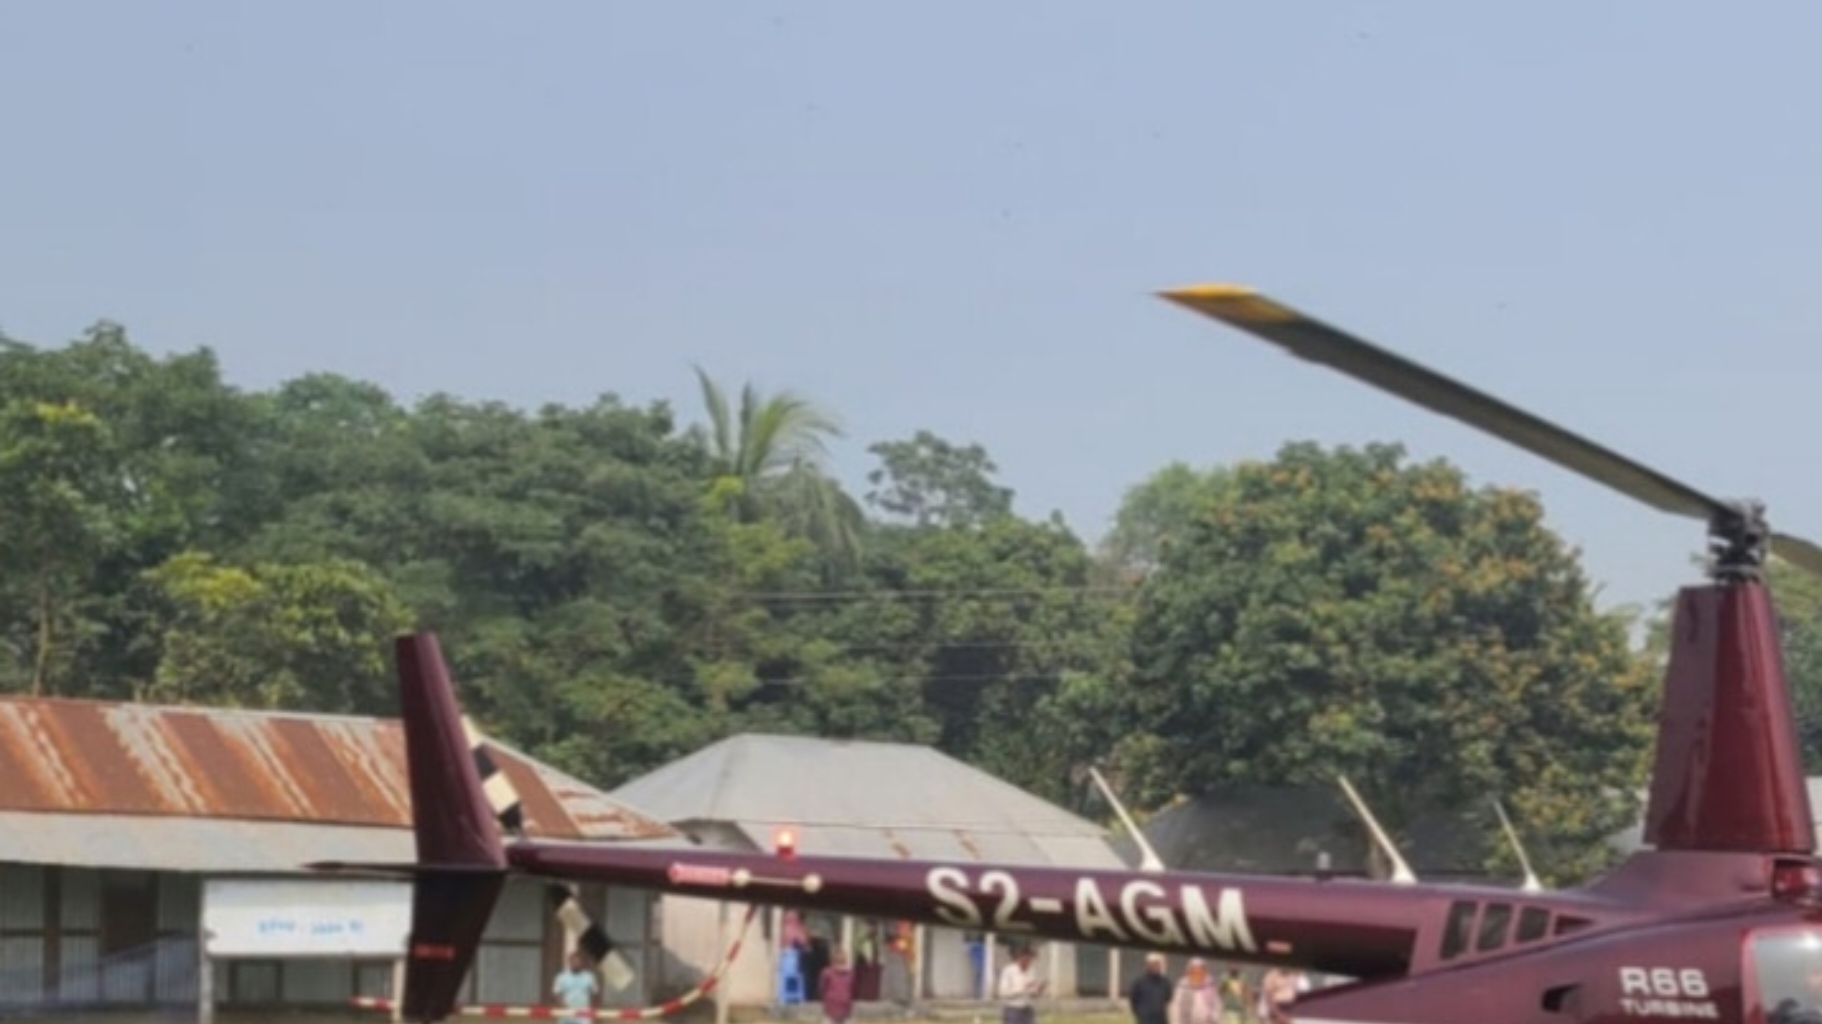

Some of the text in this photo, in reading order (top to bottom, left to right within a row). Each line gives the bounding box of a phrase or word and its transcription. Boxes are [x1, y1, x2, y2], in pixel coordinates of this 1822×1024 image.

[925, 866, 1258, 953] S2-AGM
[1619, 966, 1709, 998] R66
[1620, 998, 1720, 1019] TURBINE
